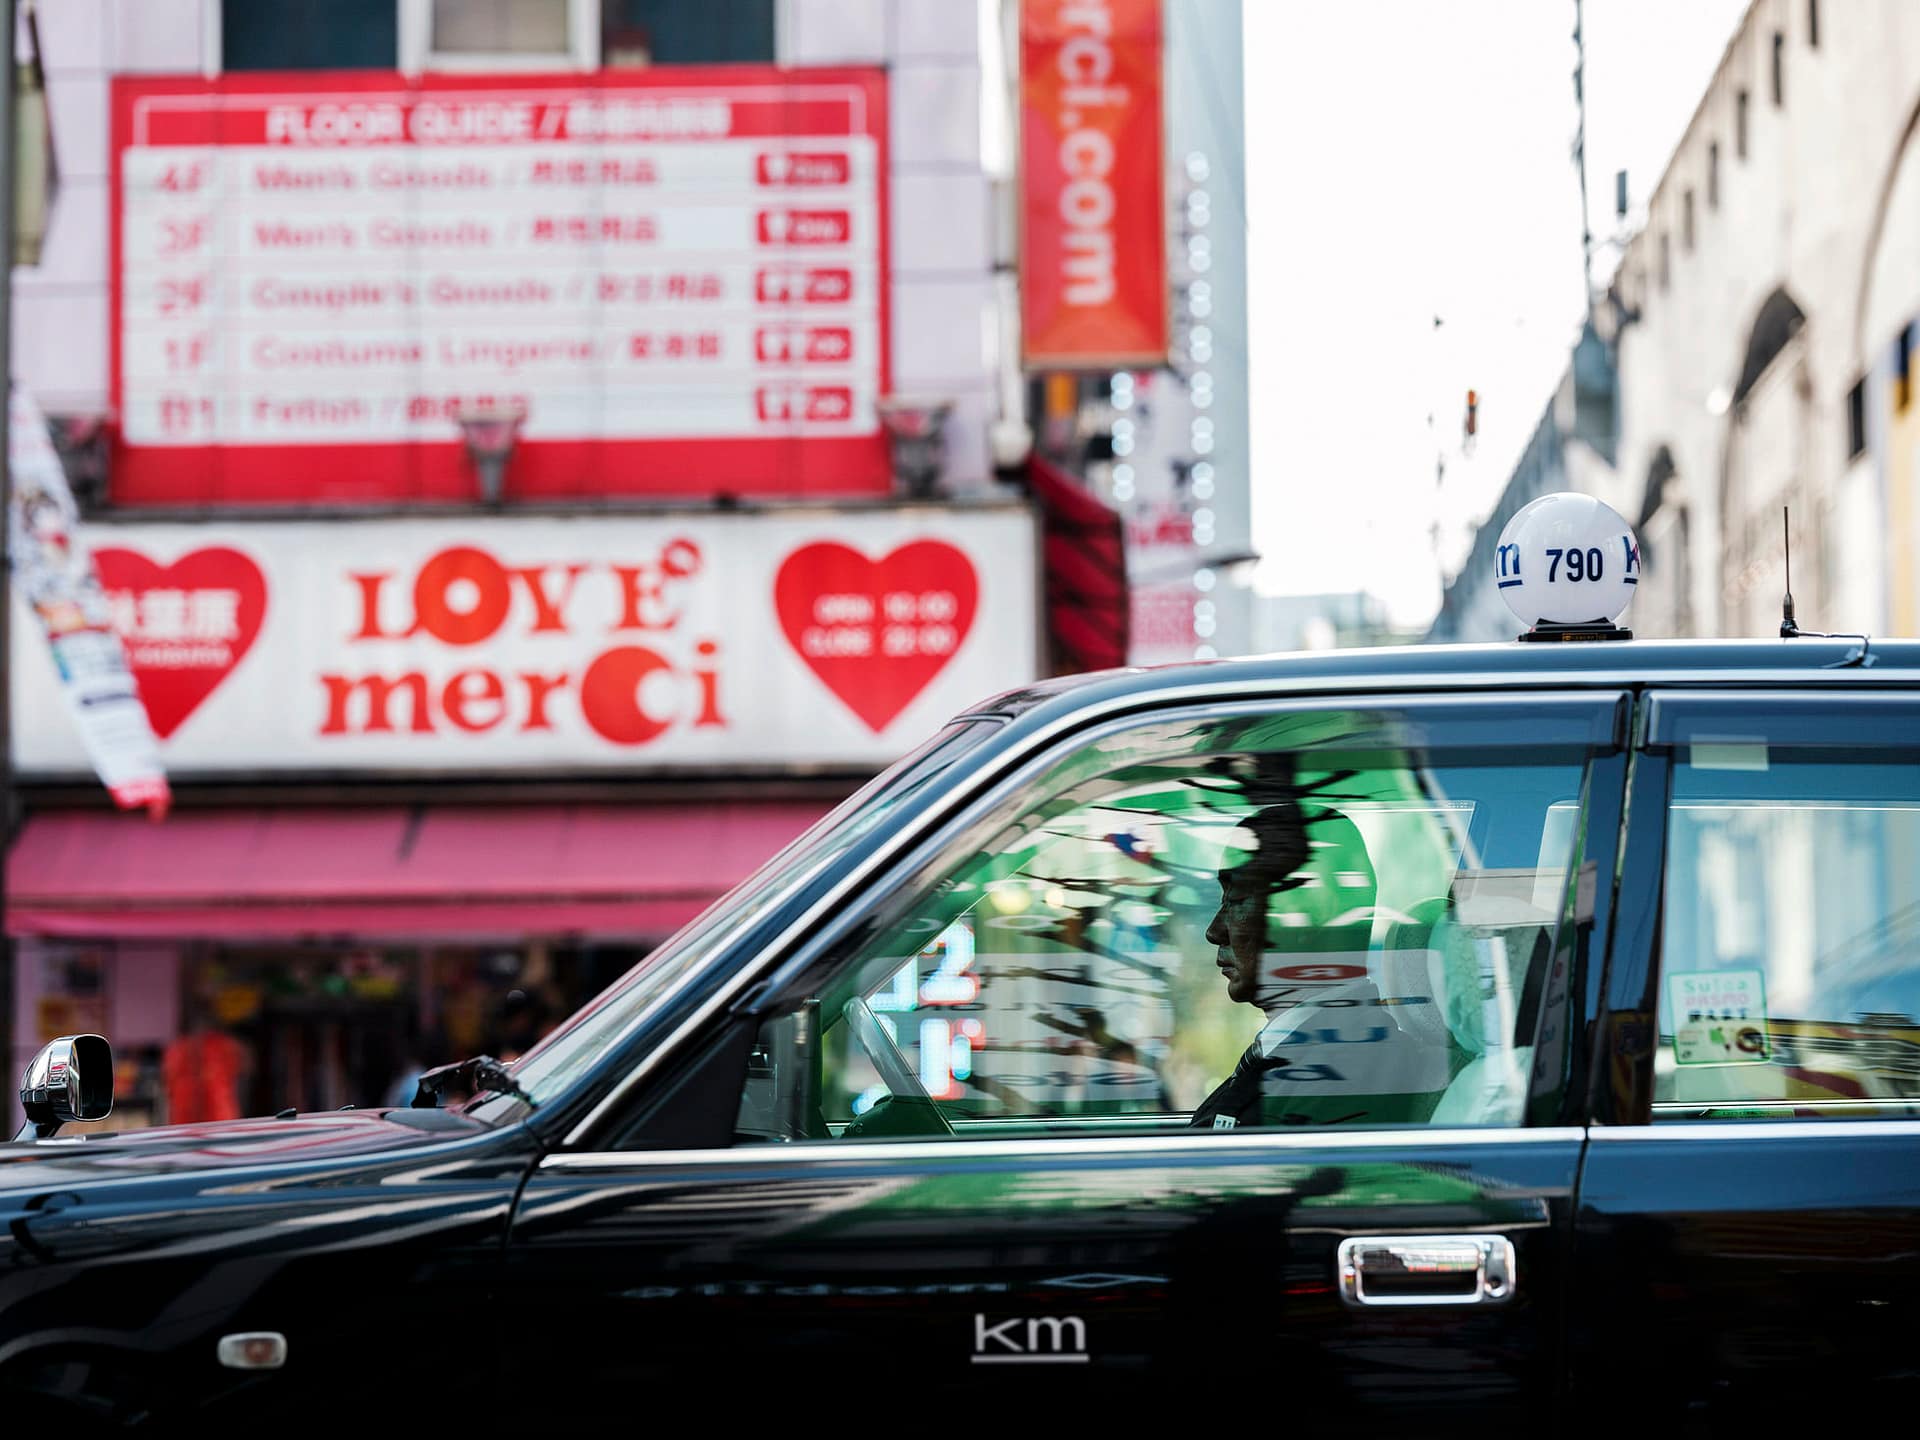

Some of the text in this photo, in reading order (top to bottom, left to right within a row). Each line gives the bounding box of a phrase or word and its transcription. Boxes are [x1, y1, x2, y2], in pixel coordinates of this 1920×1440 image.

[266, 104, 405, 142] FLOOR
[411, 102, 536, 140] GUIDE
[254, 165, 356, 191] Men's
[371, 162, 492, 190] Goods
[254, 222, 356, 249] Men's
[371, 220, 493, 249] Goods
[155, 277, 552, 317] 2F Couple's Goods
[162, 336, 209, 371] 1F
[253, 337, 426, 365] Costume
[440, 337, 593, 371] Lingerie
[253, 398, 368, 424] Fetish
[1546, 548, 1603, 582] 790
[349, 546, 684, 645] LOVE
[1683, 979, 1748, 993] Suica
[974, 1313, 1086, 1352] km
